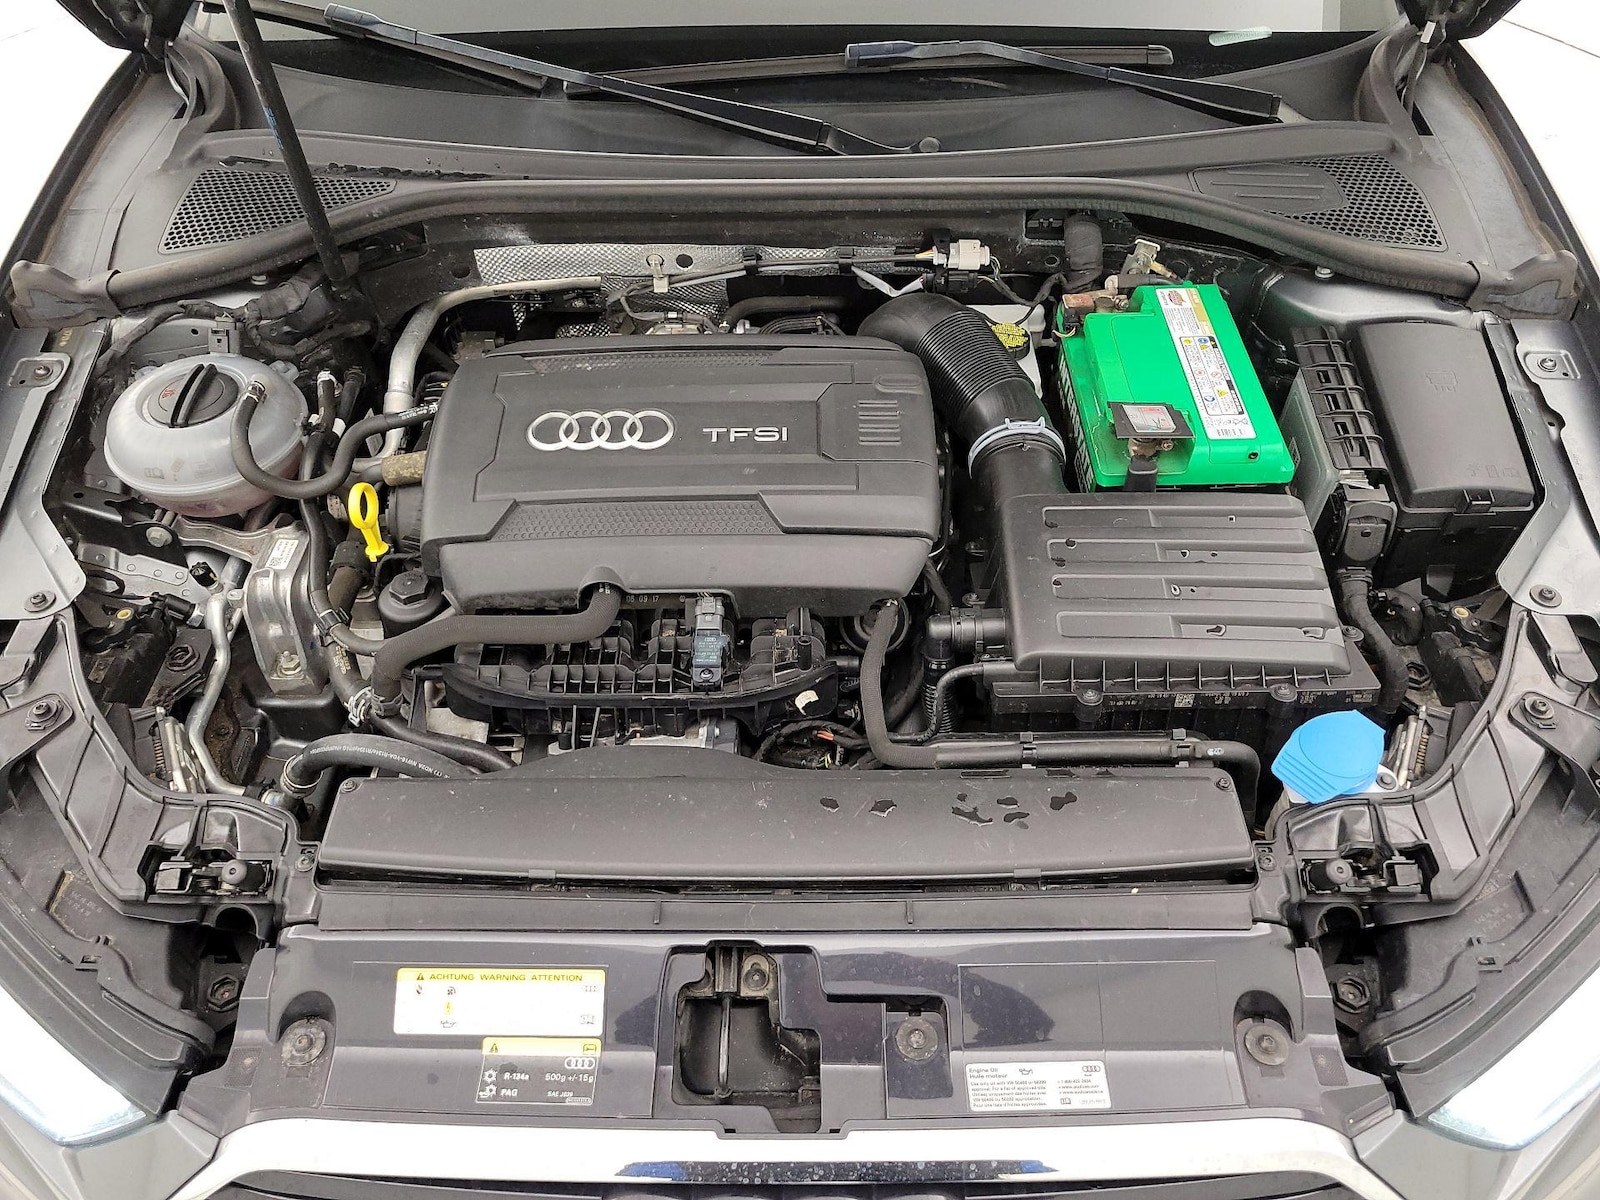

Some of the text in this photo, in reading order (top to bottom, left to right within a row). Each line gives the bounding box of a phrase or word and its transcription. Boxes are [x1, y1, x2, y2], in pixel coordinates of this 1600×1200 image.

[702, 426, 788, 444] TFSI
[652, 595, 660, 603] 17
[429, 973, 475, 981] ACHTUNG
[531, 974, 583, 982] ATTENTION
[503, 1072, 530, 1081] R-134a
[500, 1088, 518, 1097] PAG
